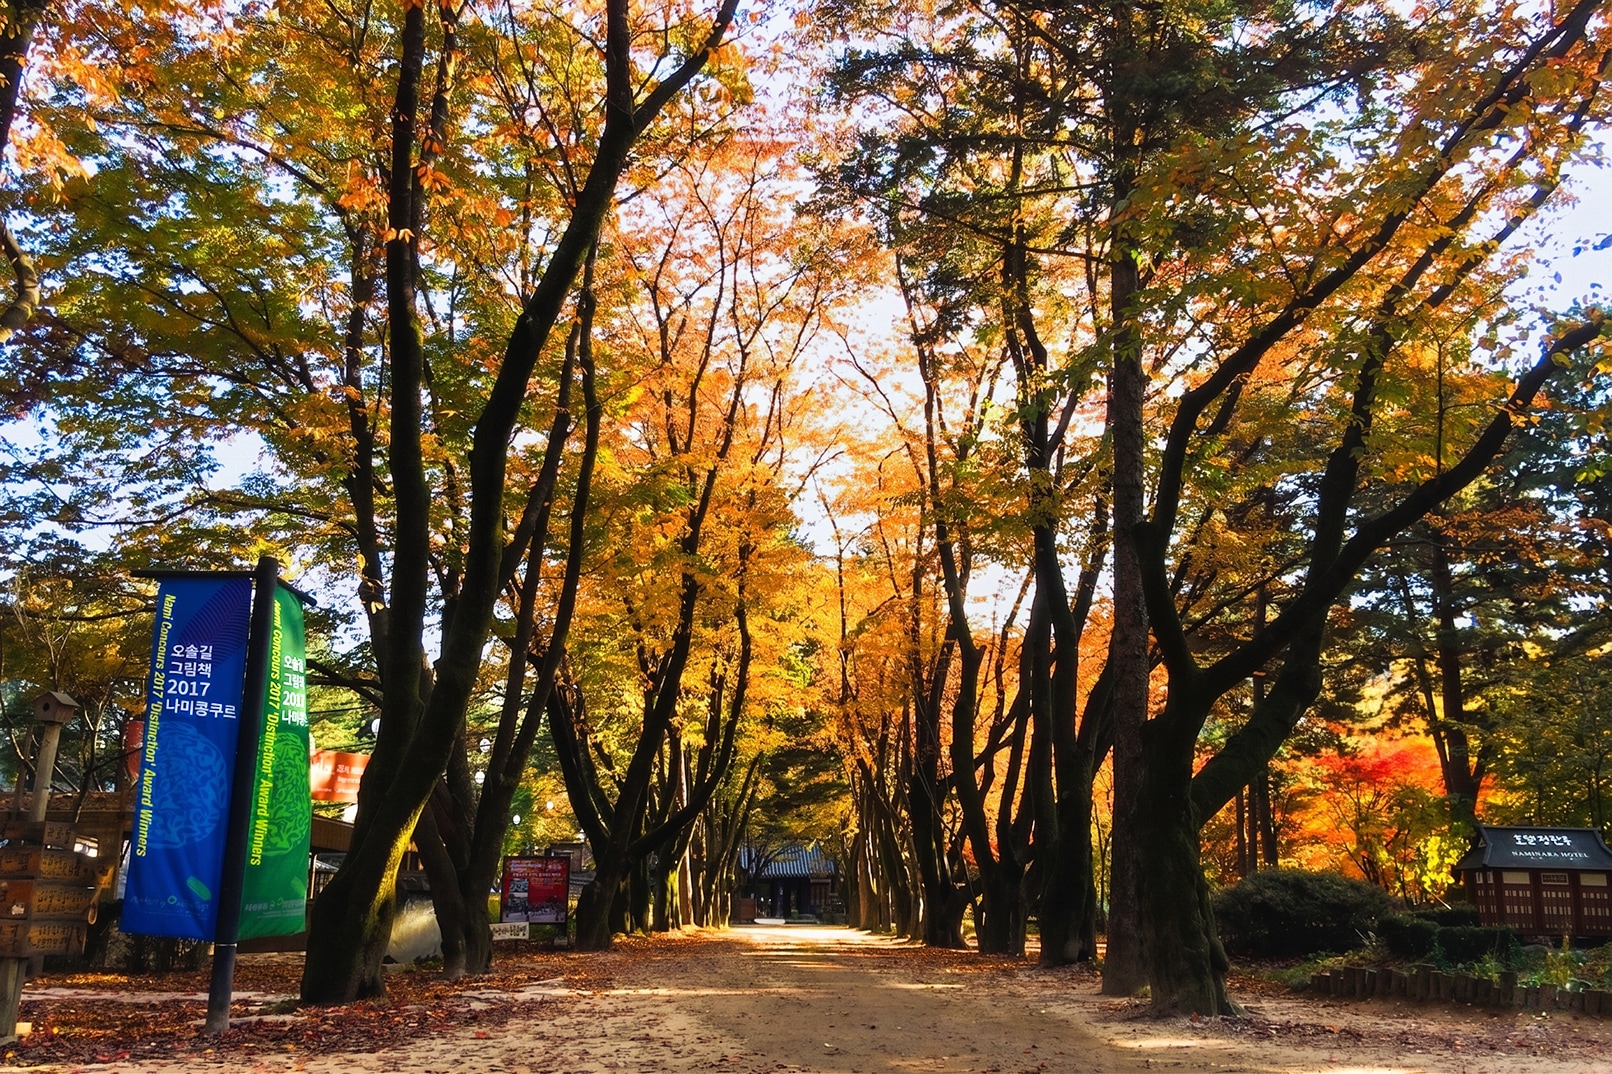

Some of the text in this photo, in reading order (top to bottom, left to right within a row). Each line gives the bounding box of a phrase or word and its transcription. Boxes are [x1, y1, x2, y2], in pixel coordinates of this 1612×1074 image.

[162, 594, 176, 620] Nami
[273, 599, 282, 629] Nami
[155, 622, 173, 670] Concours
[171, 645, 213, 660] 오솔길
[270, 630, 283, 680] Concours
[169, 662, 212, 678] 그림책
[152, 672, 165, 698] 2017
[167, 680, 210, 697] 2017
[268, 681, 281, 710] 2017
[166, 699, 236, 719] 나미콩쿠르
[141, 768, 157, 807] Award
[256, 778, 273, 817] Award
[136, 809, 153, 857] Winners
[250, 819, 268, 866] Winners
